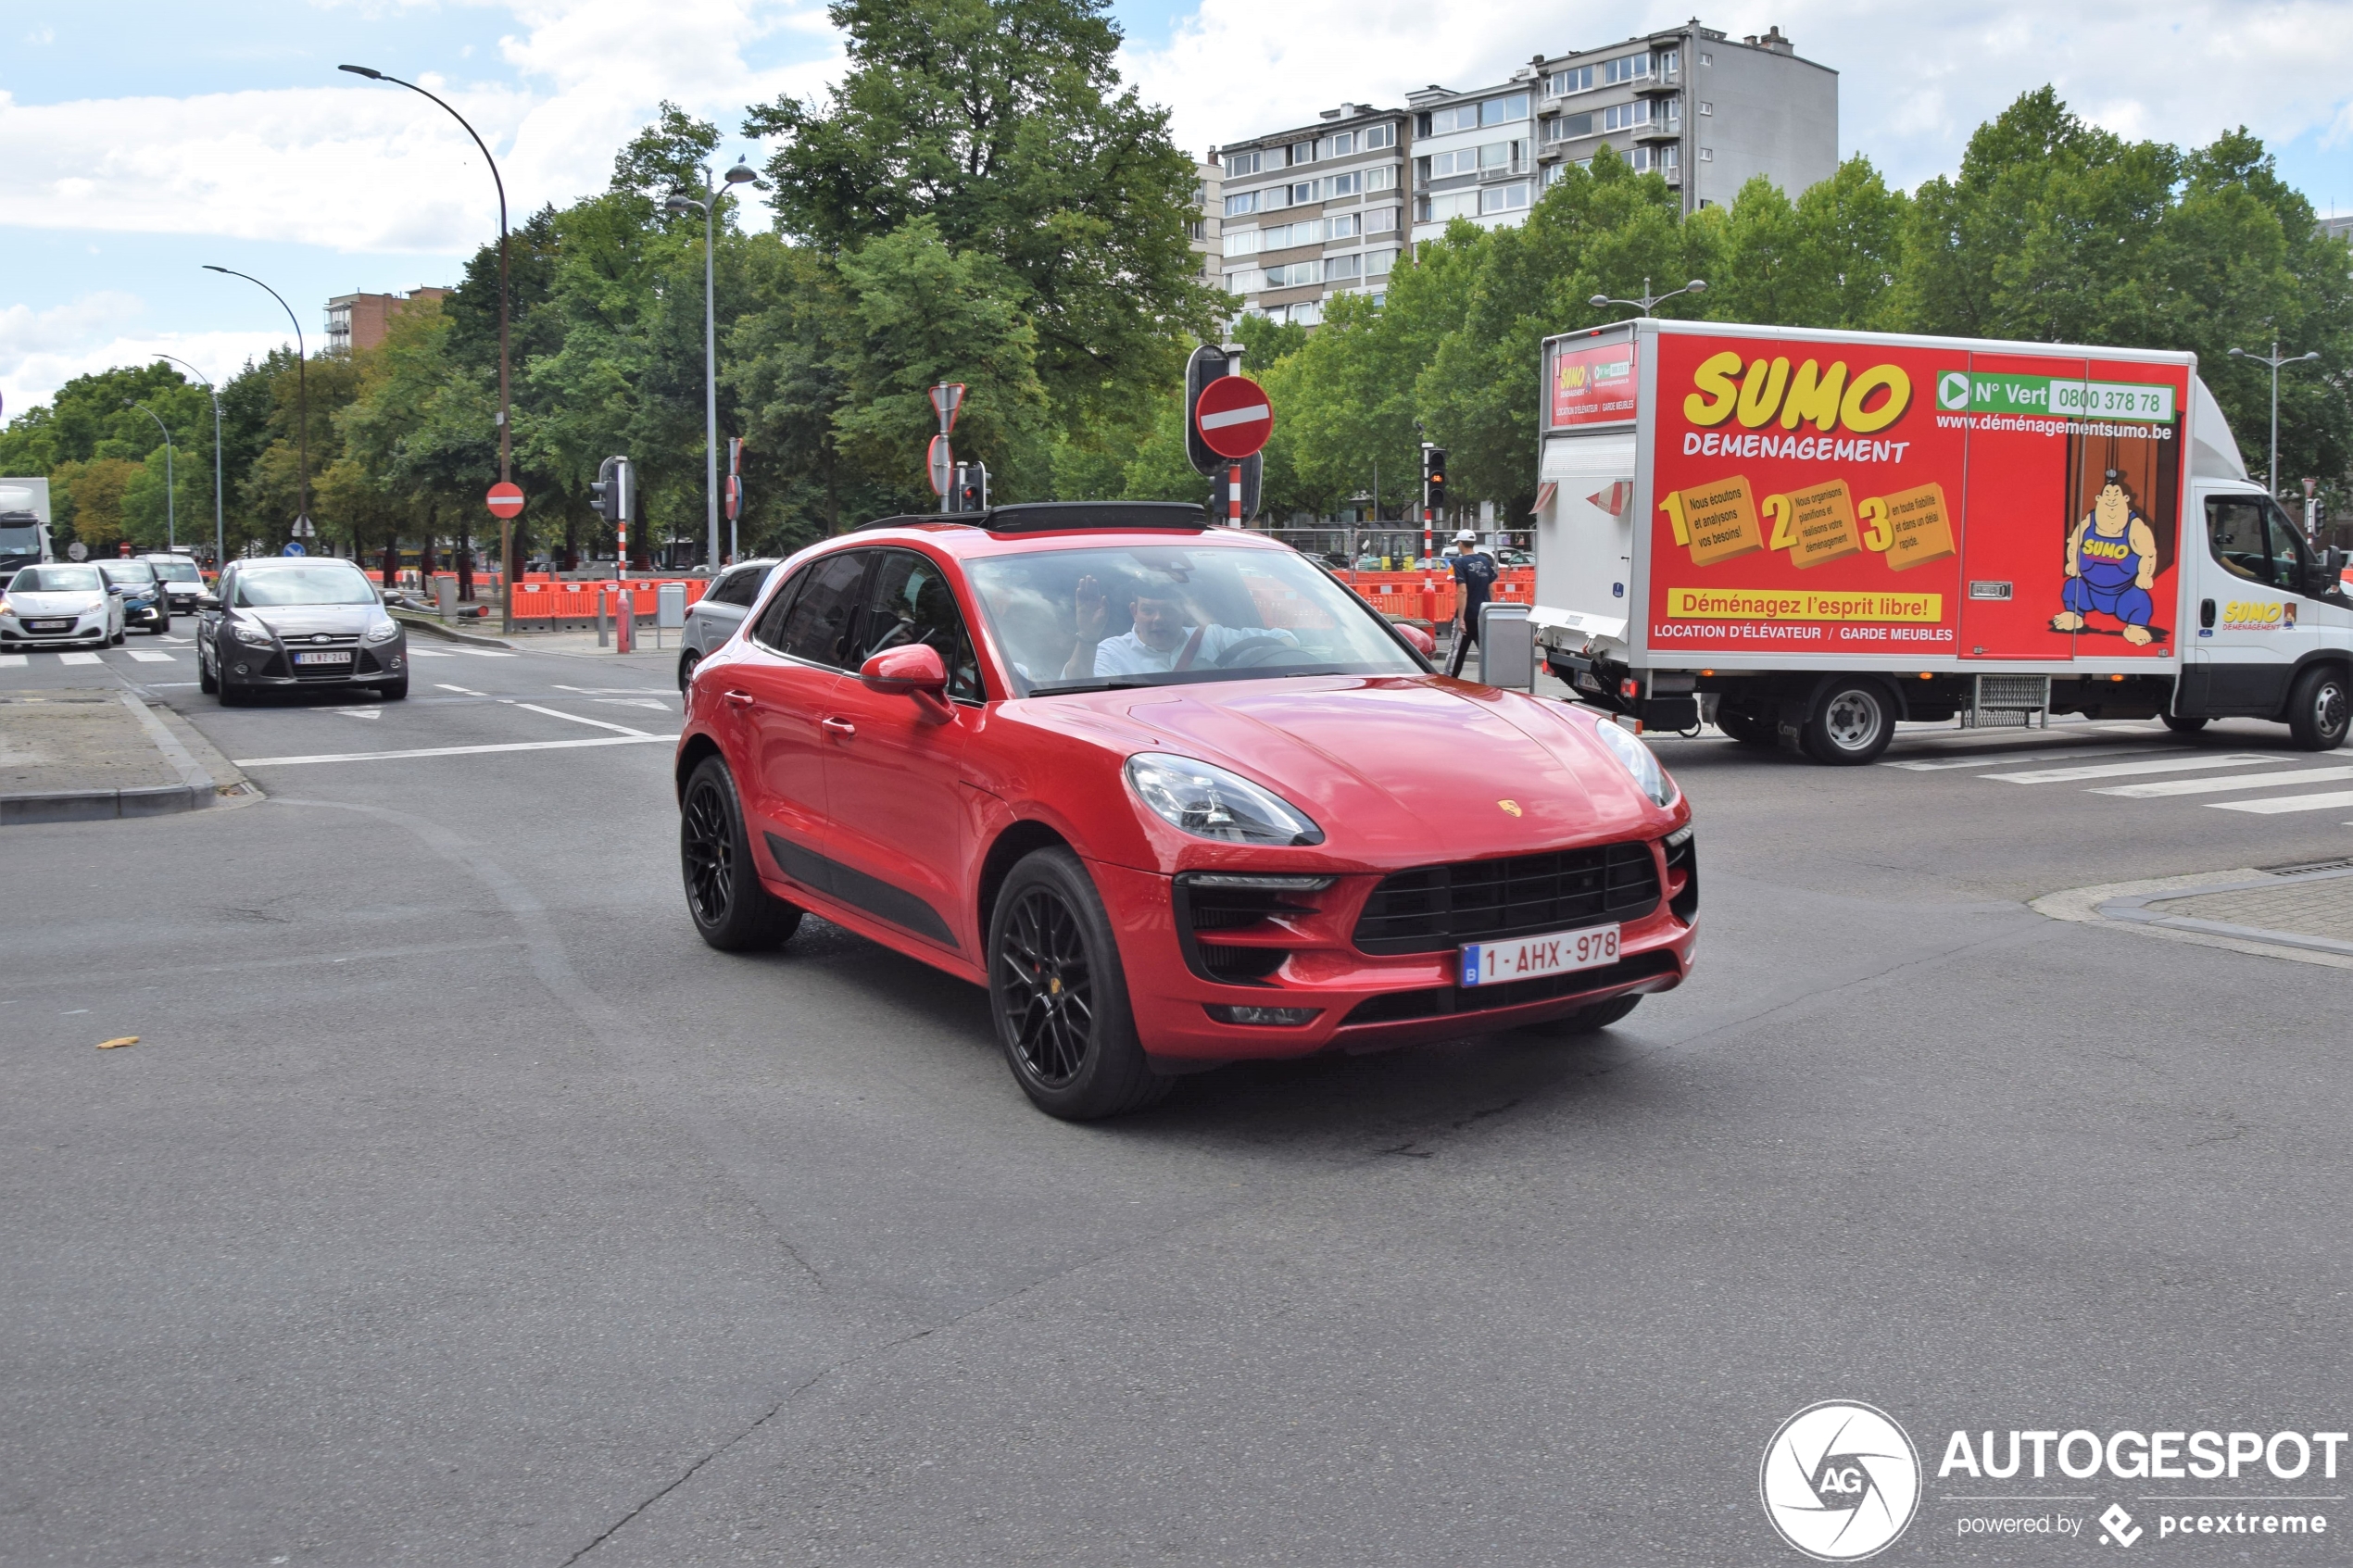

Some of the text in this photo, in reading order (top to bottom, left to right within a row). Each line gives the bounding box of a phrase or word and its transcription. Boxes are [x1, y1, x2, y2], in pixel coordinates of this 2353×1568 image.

[1560, 365, 1585, 389] SUMO
[1683, 351, 1912, 433] SUMO
[2005, 383, 2046, 406] Vert
[2058, 387, 2100, 409] 0800
[2104, 391, 2135, 412] 378
[2140, 394, 2160, 413] 78
[1936, 414, 2172, 440] www.déménagementsumo.be
[1683, 433, 1909, 463] DEMENAGEMENT
[1690, 488, 1742, 510] Nous écoutons
[1795, 488, 1842, 508] Nous organisons
[1892, 493, 1935, 516] en toute fiabilité
[1658, 491, 1690, 546] 1
[1694, 509, 1738, 529] et analysons
[1762, 494, 1797, 551] 2
[1799, 505, 1833, 525] planifions et
[1858, 496, 1894, 552] 3
[1895, 511, 1939, 533] et dans un délai
[1698, 525, 1743, 548] vos besoins!
[1802, 520, 1843, 537] réalisons votre
[1806, 533, 1847, 553] déménagement
[1899, 535, 1919, 551] rapide.
[2082, 538, 2129, 559] SUMO
[1682, 593, 1929, 619] Déménagez l'esprit libre!
[2223, 600, 2283, 623] SUMO
[1654, 624, 1726, 638] LOCATION
[1729, 622, 1821, 640] D'ÉLÉVATEUR
[1840, 627, 1887, 640] GARDE
[1891, 628, 1953, 642] MEUBLES
[1466, 931, 1617, 982] B 1-AHX-978
